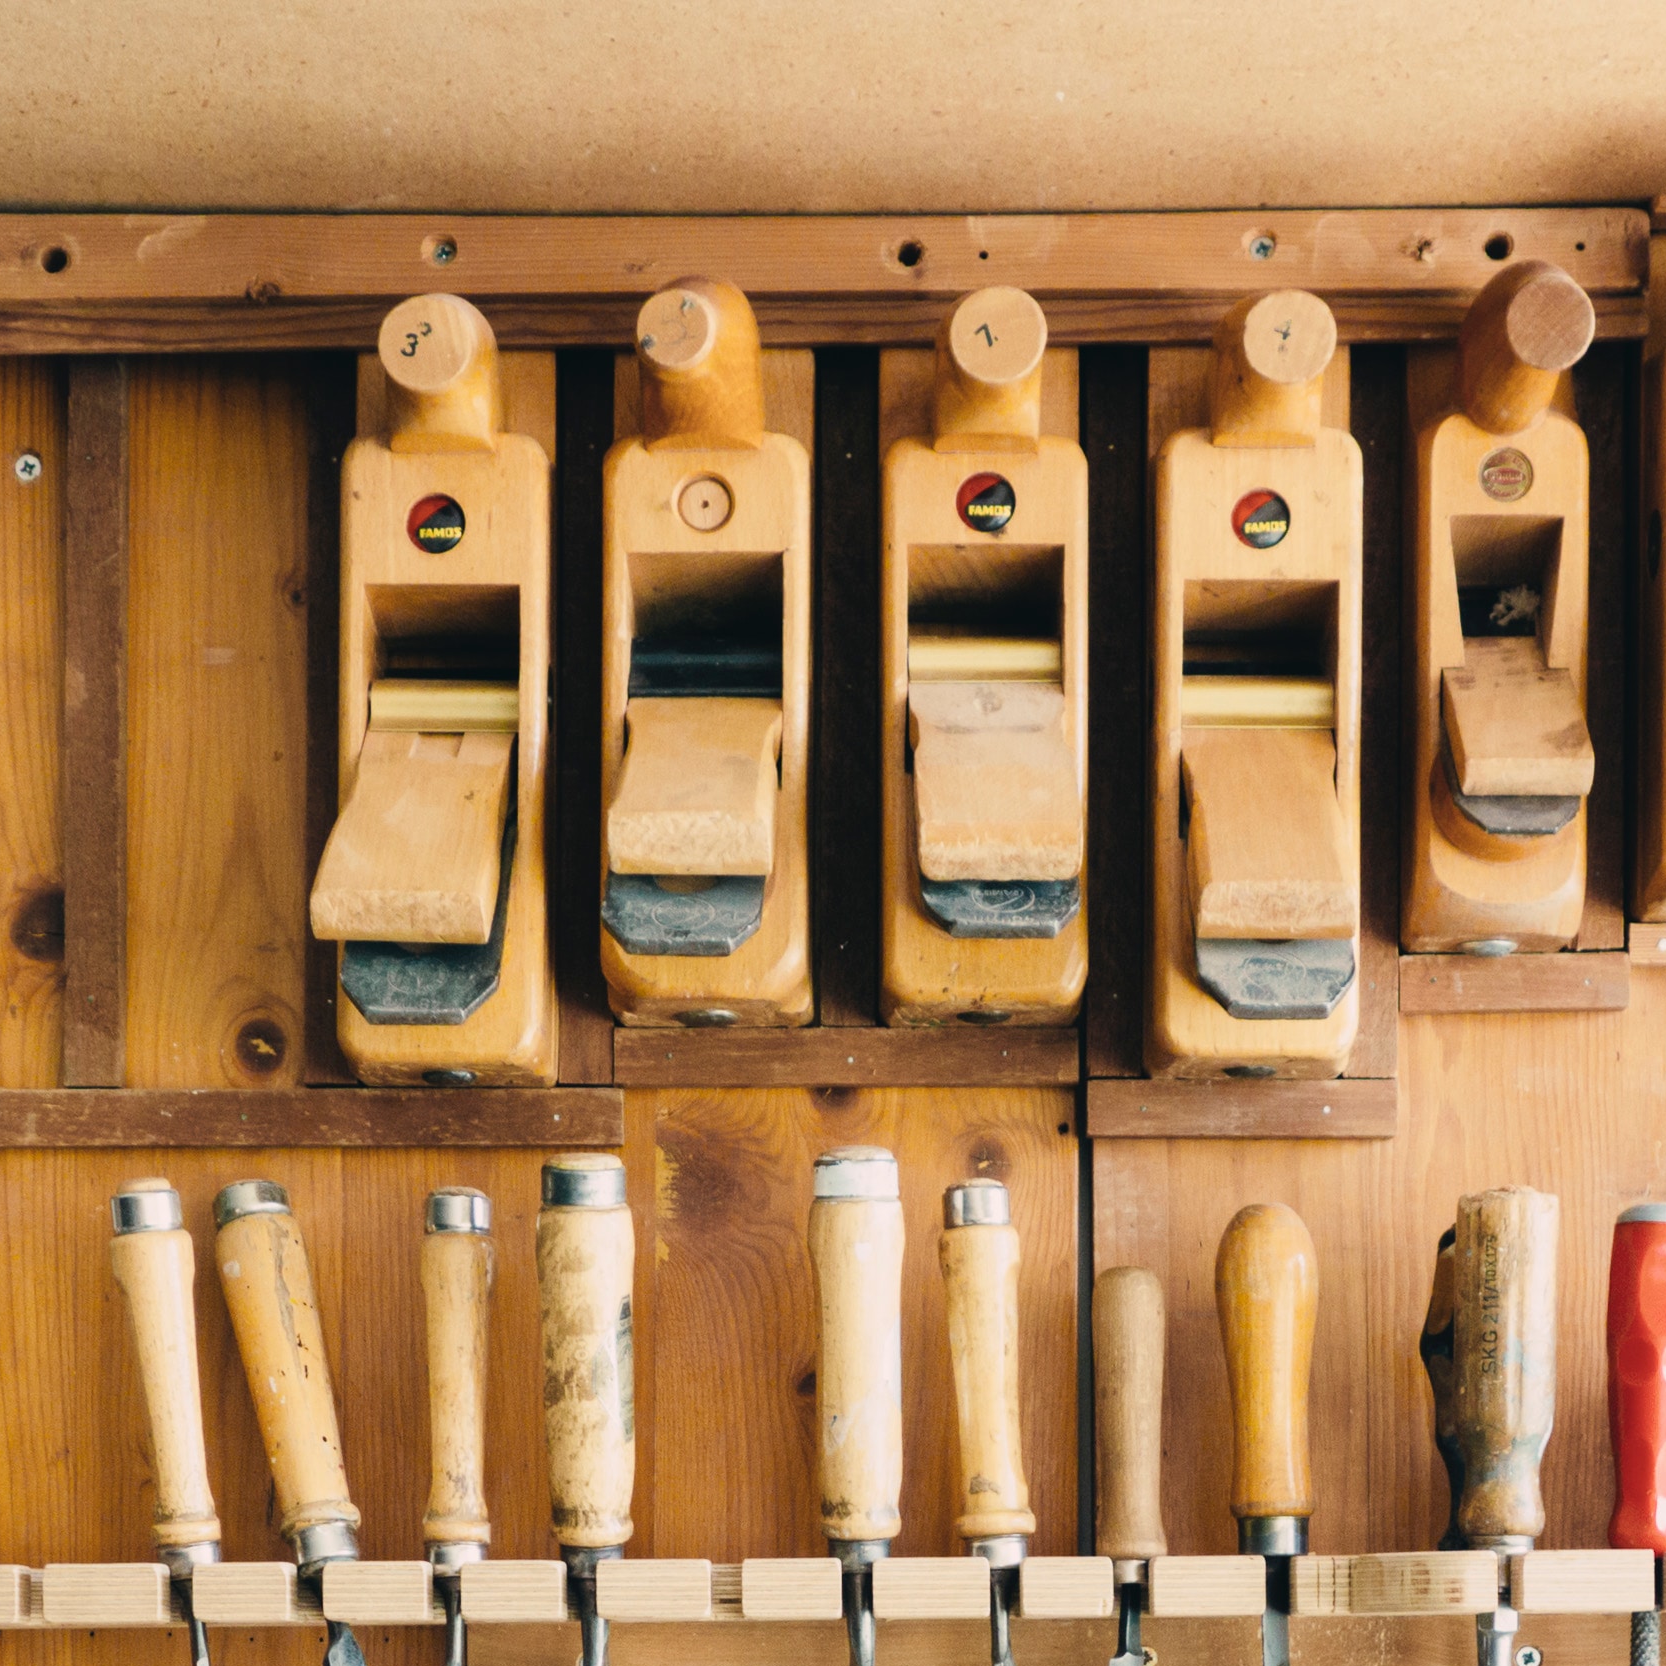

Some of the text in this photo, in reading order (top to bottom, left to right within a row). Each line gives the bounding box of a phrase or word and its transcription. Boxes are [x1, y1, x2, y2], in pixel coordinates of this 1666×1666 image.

[967, 504, 1012, 517] FAMOS
[418, 526, 463, 539] FAMOS
[1243, 520, 1288, 535] FAMOS
[1481, 1329, 1499, 1374] SKG
